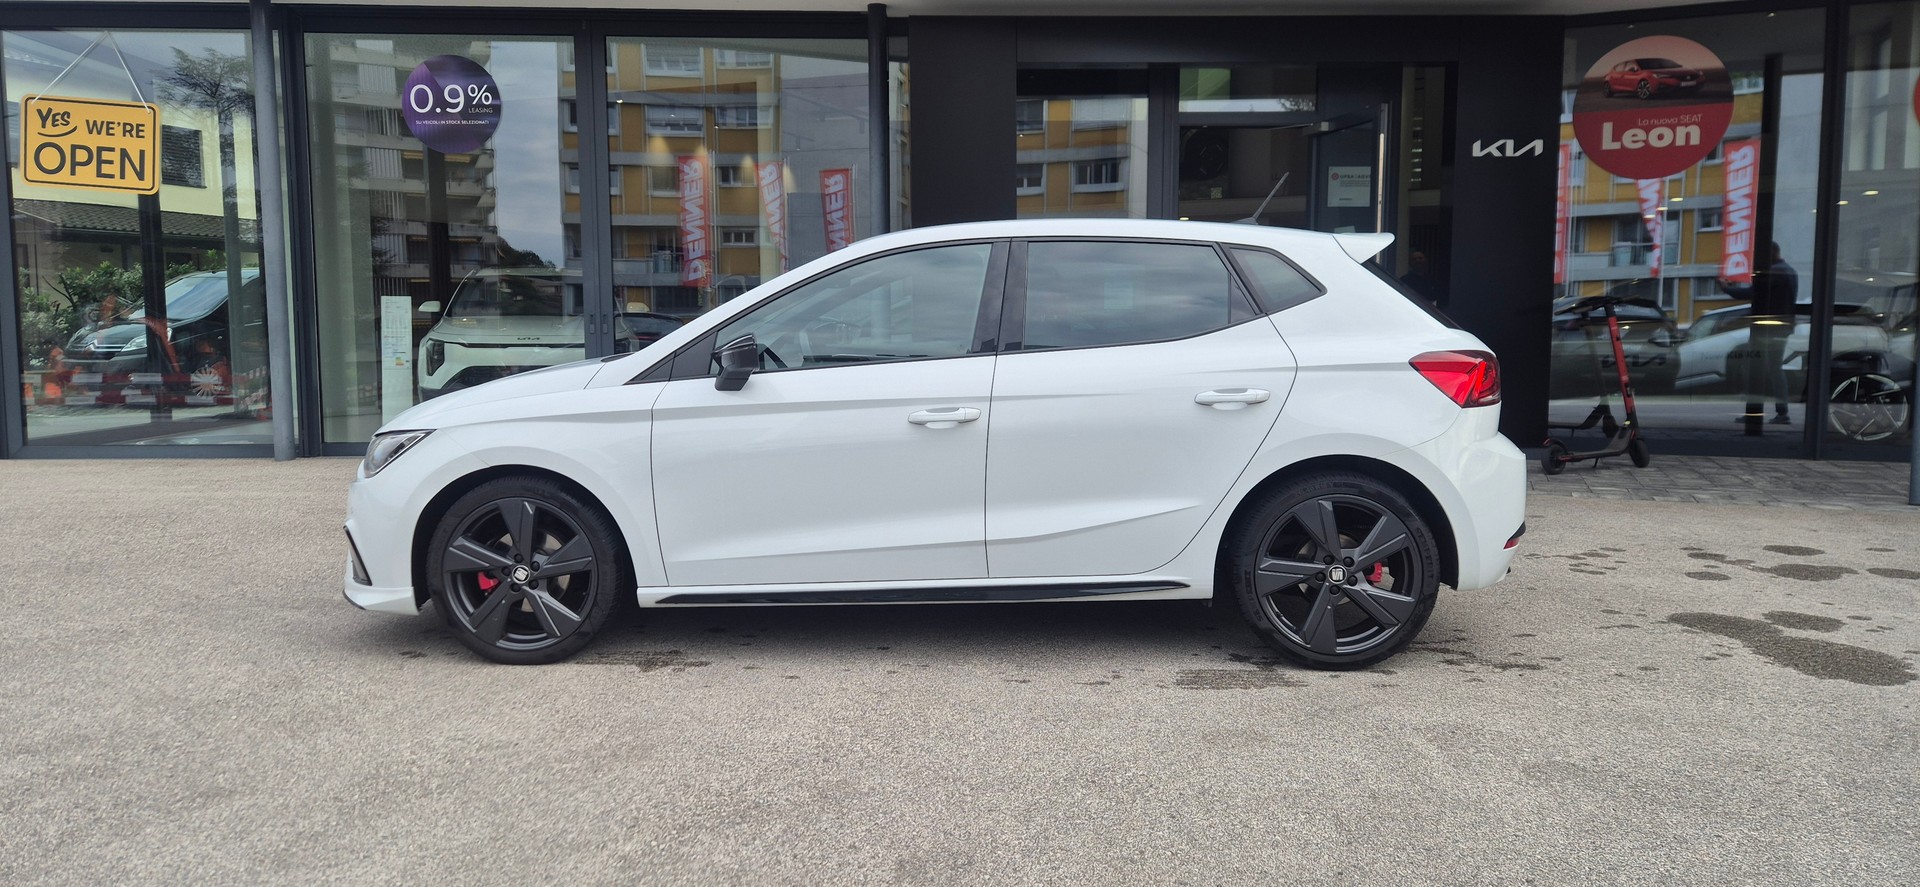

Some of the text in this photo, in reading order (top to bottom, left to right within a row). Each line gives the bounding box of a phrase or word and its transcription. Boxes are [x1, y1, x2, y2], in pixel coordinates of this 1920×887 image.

[409, 84, 493, 113] 0.9%
[36, 107, 146, 139] YES WE'RE
[1638, 113, 1704, 126] La nuova SEAT
[1472, 138, 1544, 157] KIA
[1602, 121, 1701, 150] Leon
[33, 142, 146, 182] OPEN
